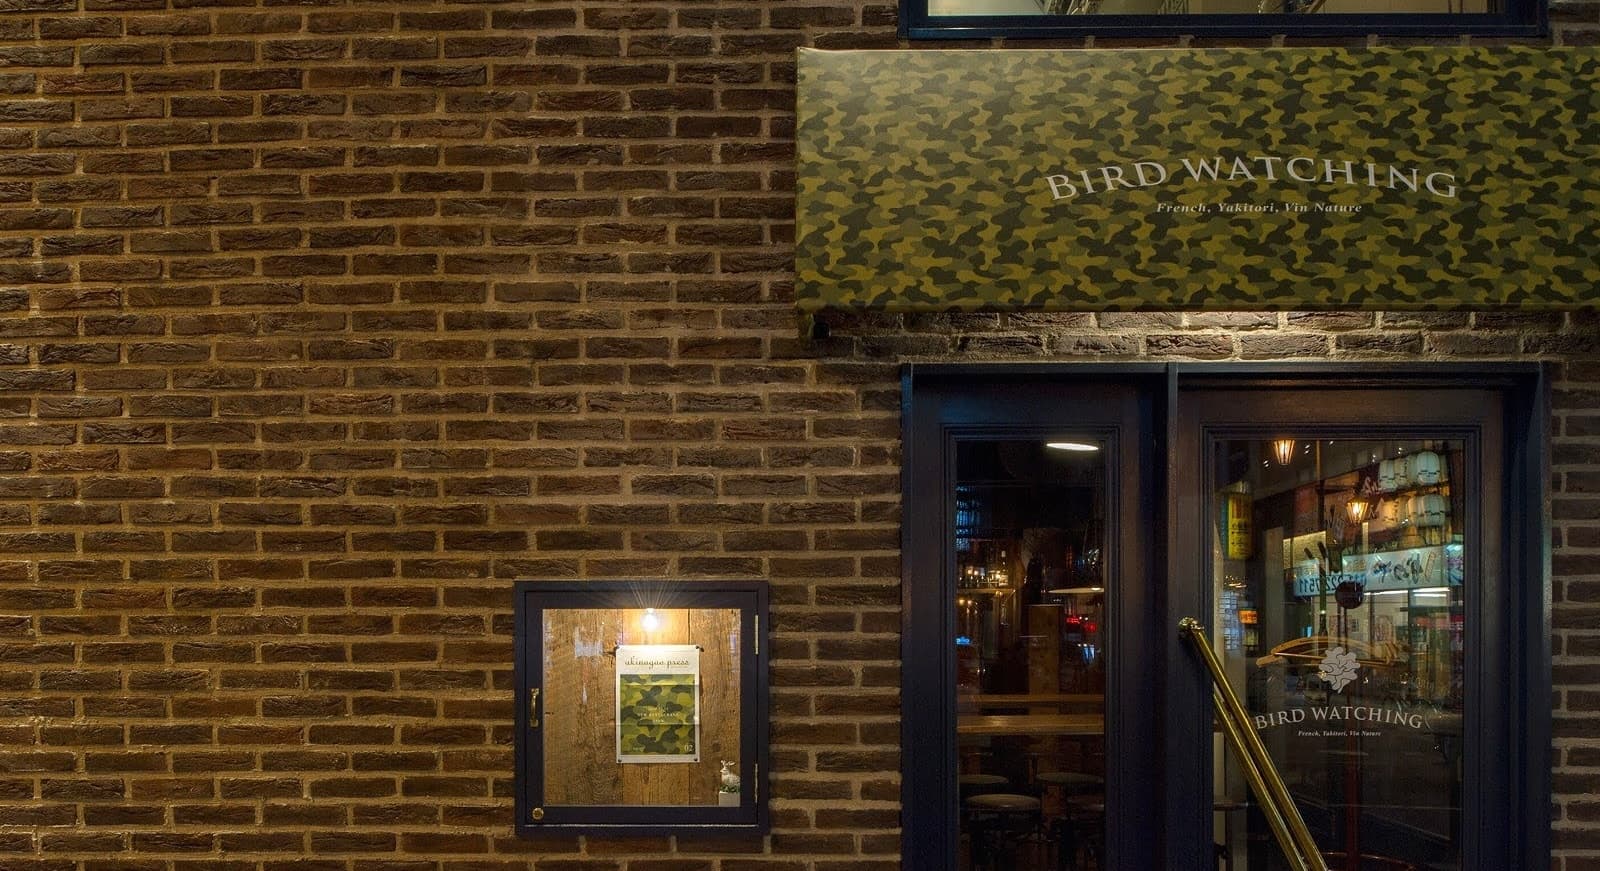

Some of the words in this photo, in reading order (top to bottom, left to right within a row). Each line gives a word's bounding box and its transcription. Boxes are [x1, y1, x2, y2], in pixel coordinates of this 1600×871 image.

[1045, 160, 1168, 201] BIRD
[1181, 156, 1457, 198] WATCHING
[1156, 202, 1211, 214] French,
[1218, 202, 1279, 214] Yakitori,
[1285, 202, 1308, 213] Vin
[1314, 202, 1363, 213] Nature
[666, 659, 689, 669] press
[1255, 708, 1306, 730] BIRD
[1311, 706, 1423, 729] WATCHING
